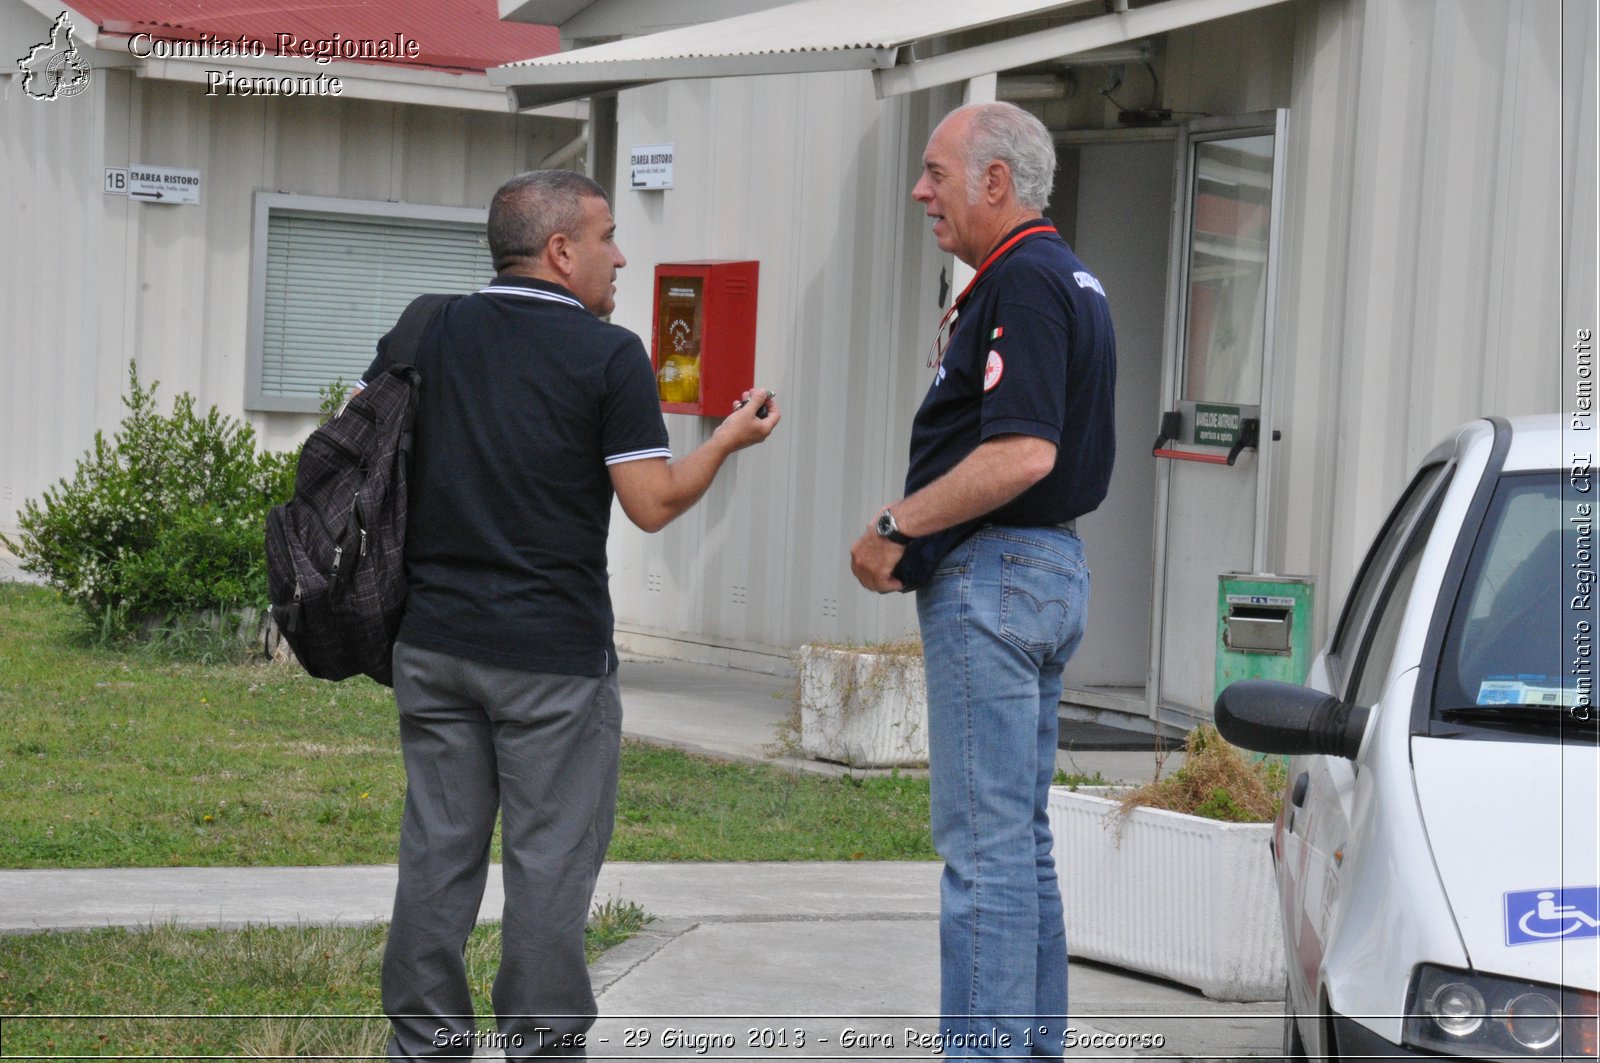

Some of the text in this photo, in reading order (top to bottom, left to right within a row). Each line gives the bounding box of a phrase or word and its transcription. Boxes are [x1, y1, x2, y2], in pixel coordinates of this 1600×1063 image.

[651, 153, 673, 165] RISTORO
[107, 172, 125, 189] 1B
[140, 173, 199, 186] AREA RISTORO
